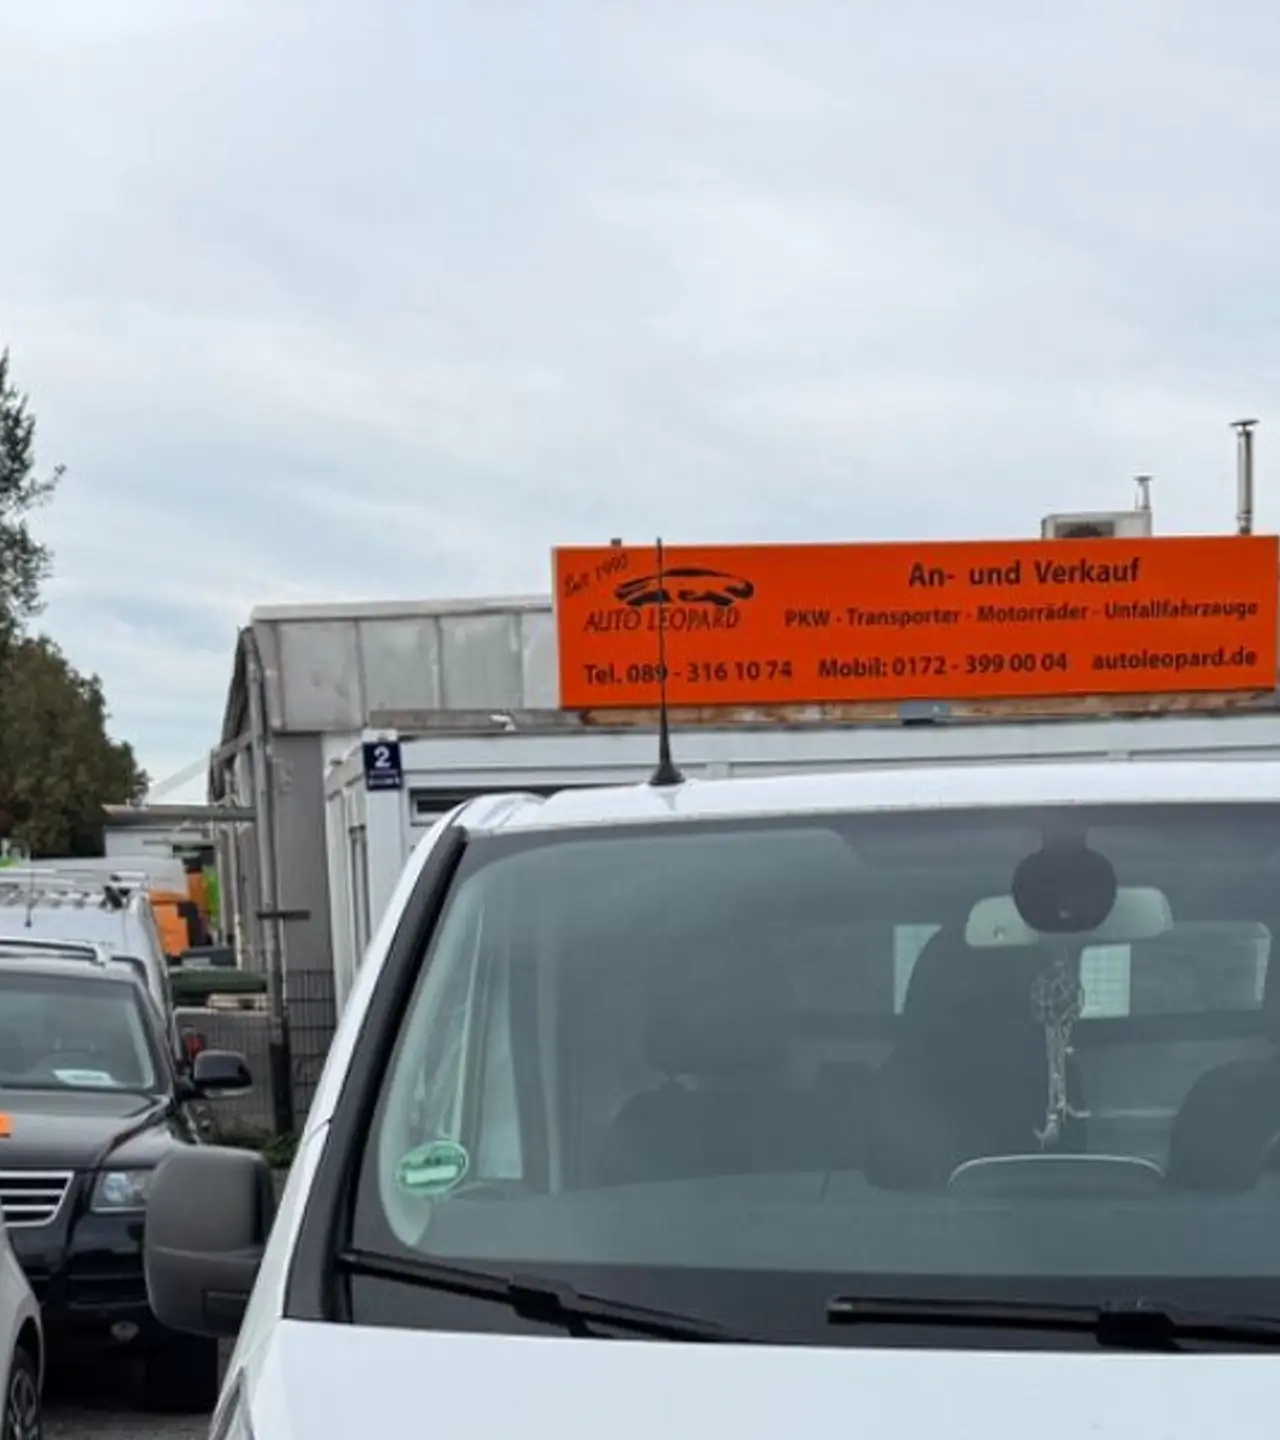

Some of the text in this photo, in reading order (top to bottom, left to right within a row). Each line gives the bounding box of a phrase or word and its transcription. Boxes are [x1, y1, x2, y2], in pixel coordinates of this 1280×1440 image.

[909, 557, 1141, 588] An- und Verkauf
[583, 606, 741, 632] AUTO LEOPARD
[784, 598, 1258, 629] PKW Transporter Motorräder Unfallfahrzeuge
[584, 662, 622, 686] Tel.
[626, 661, 667, 685] 089
[686, 660, 728, 683] 316
[733, 659, 761, 682] 10
[765, 658, 793, 680] 74
[818, 657, 888, 680] Mobil:
[891, 654, 946, 677] 0172
[966, 653, 1007, 674] 399
[1010, 653, 1037, 673] 00
[1040, 652, 1068, 672] 04
[1093, 645, 1258, 672] autoleopard.de
[373, 745, 392, 768] 2
